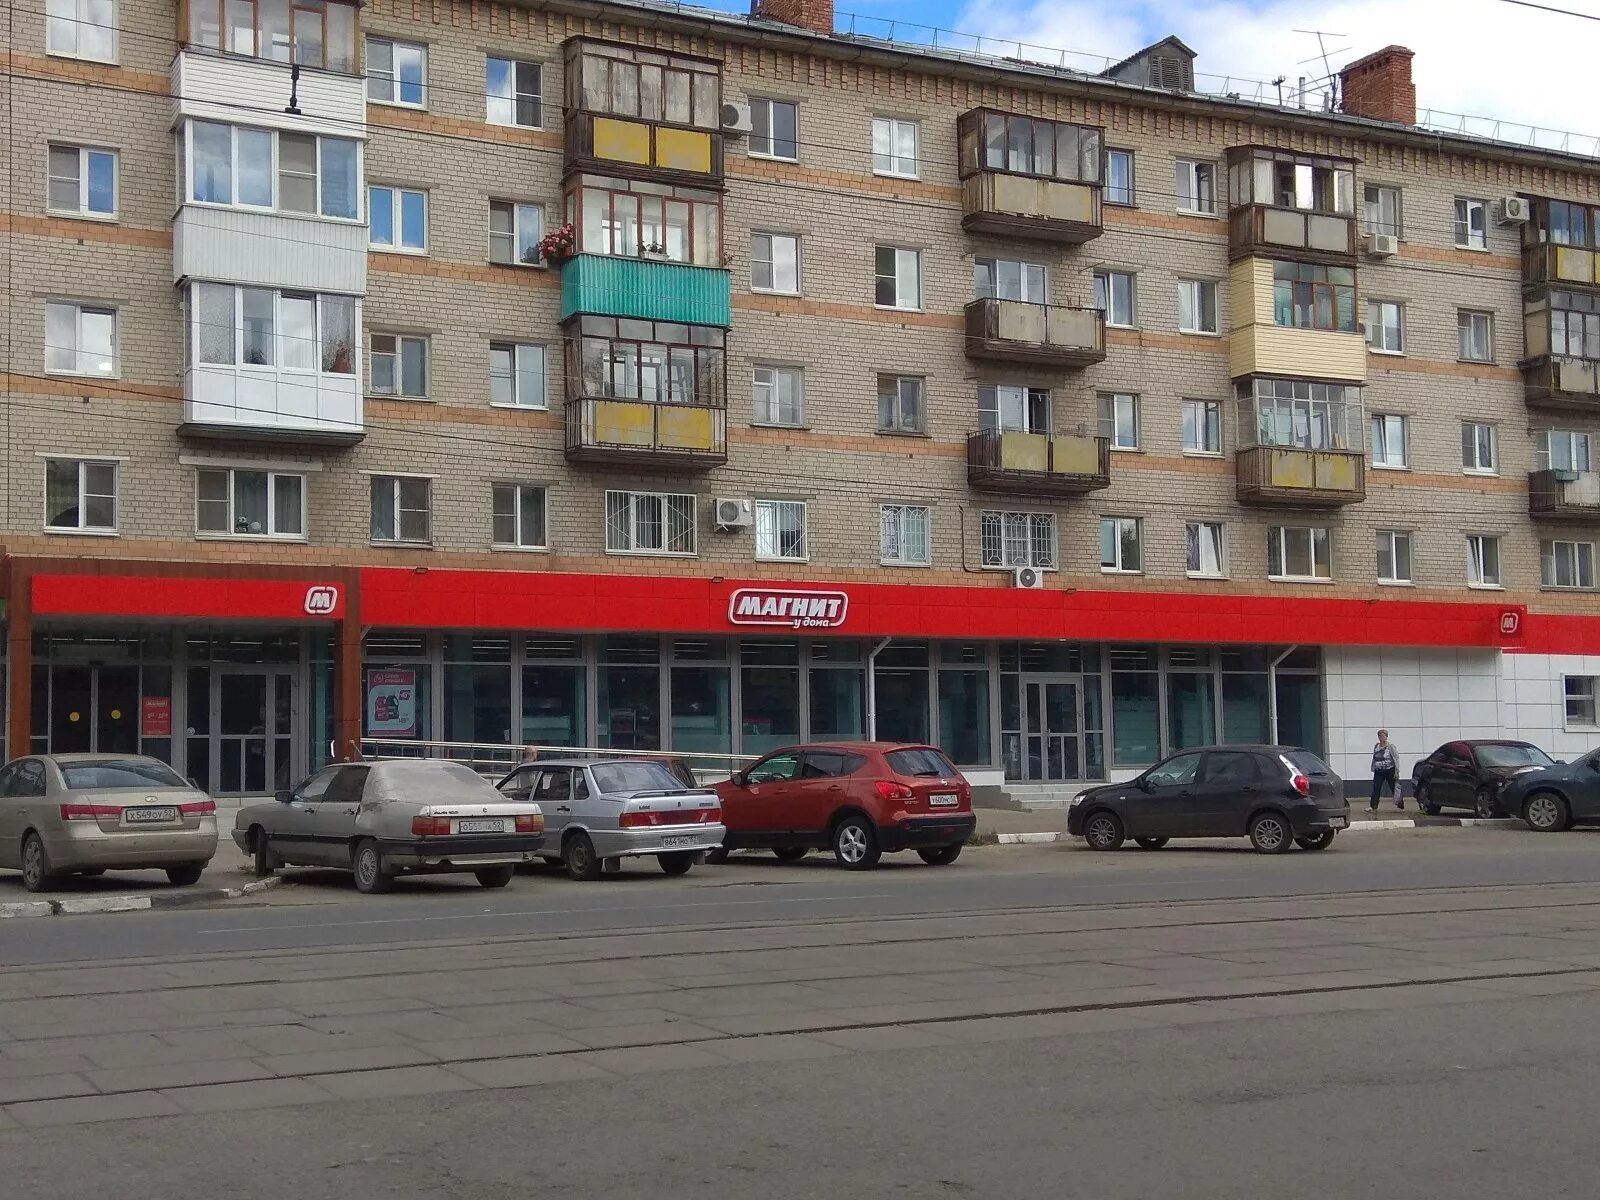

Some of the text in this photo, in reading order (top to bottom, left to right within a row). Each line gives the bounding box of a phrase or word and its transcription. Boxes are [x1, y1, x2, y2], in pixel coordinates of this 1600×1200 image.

[736, 596, 841, 618] МАГНИТ
[793, 617, 830, 628] у дома
